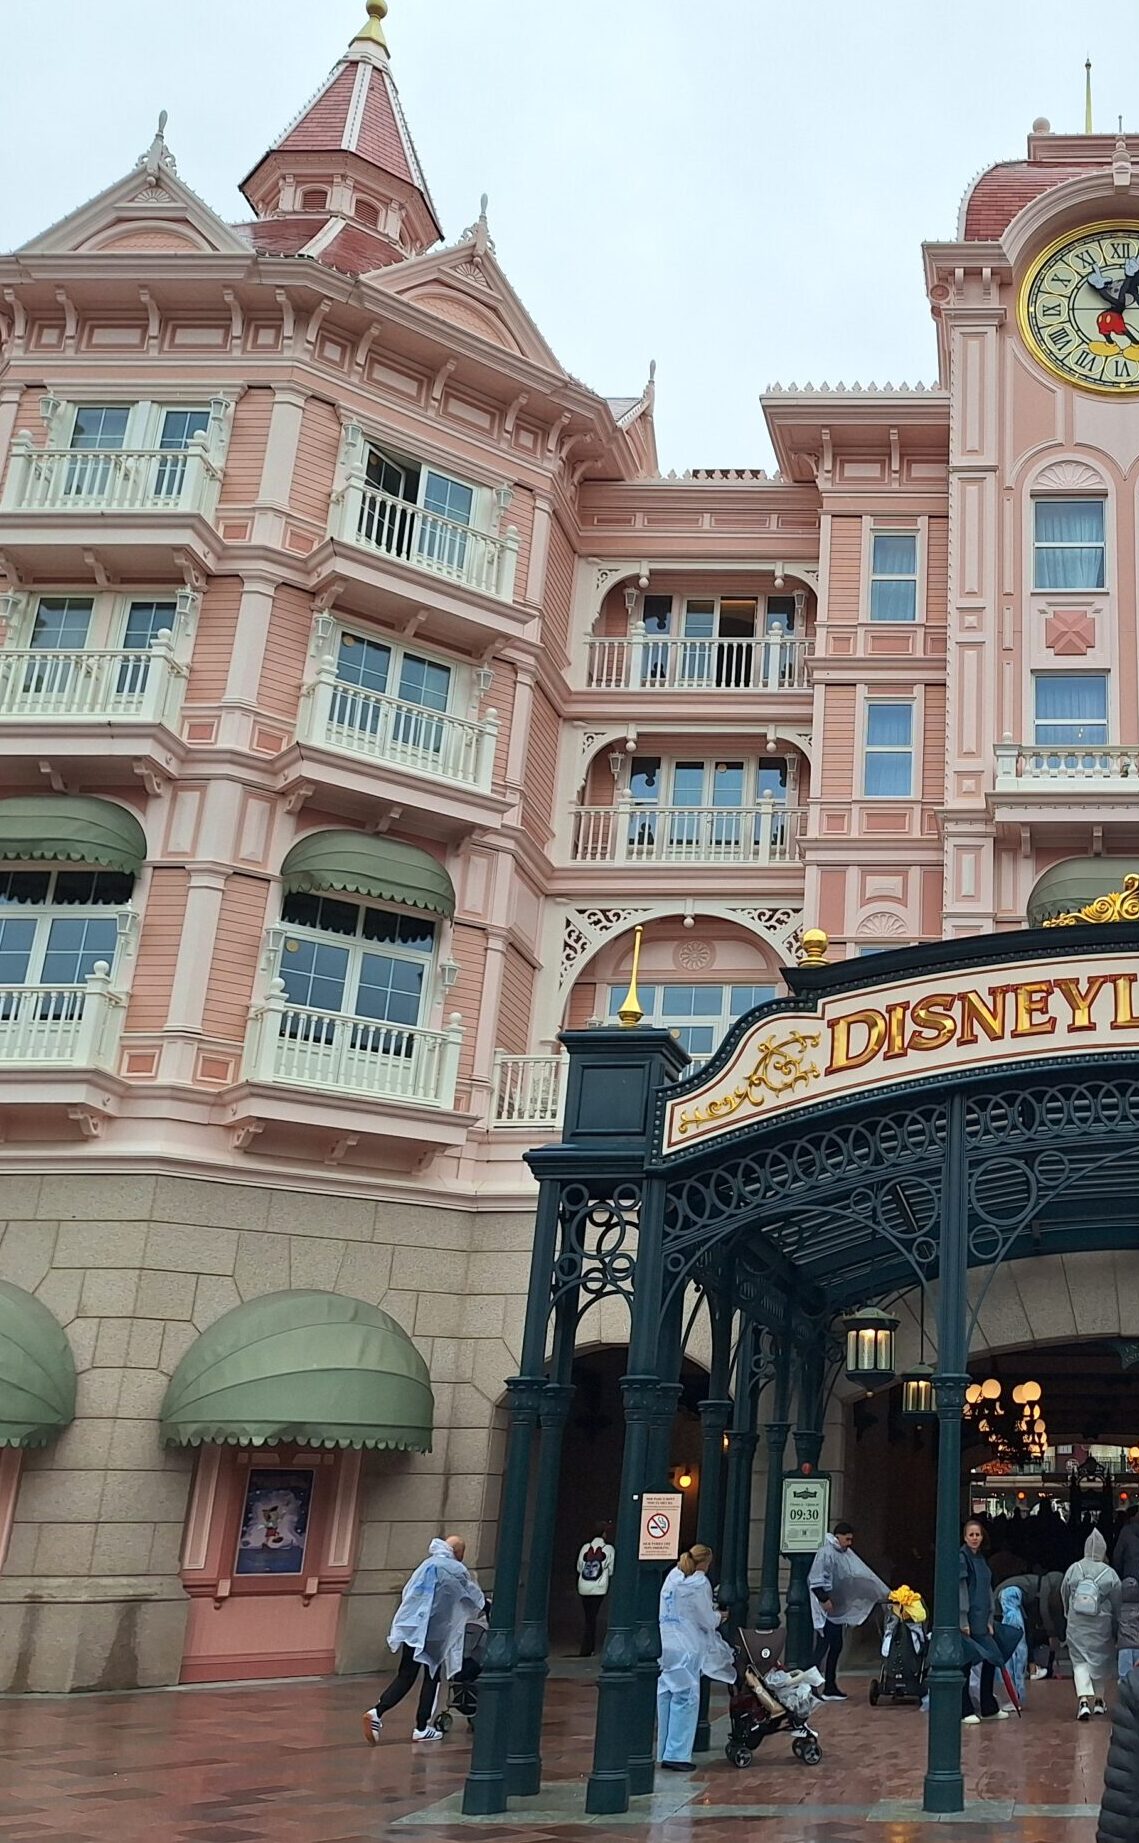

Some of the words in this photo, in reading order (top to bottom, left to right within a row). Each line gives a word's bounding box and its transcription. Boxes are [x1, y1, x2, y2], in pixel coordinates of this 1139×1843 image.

[1110, 243, 1130, 259] XII
[1075, 250, 1096, 269] XI
[1051, 273, 1071, 288] X
[1042, 303, 1061, 317] IX
[1048, 327, 1073, 351] VIII
[1074, 350, 1096, 371] VII
[1114, 360, 1131, 377] VI
[790, 1509, 819, 1520] 09:30
